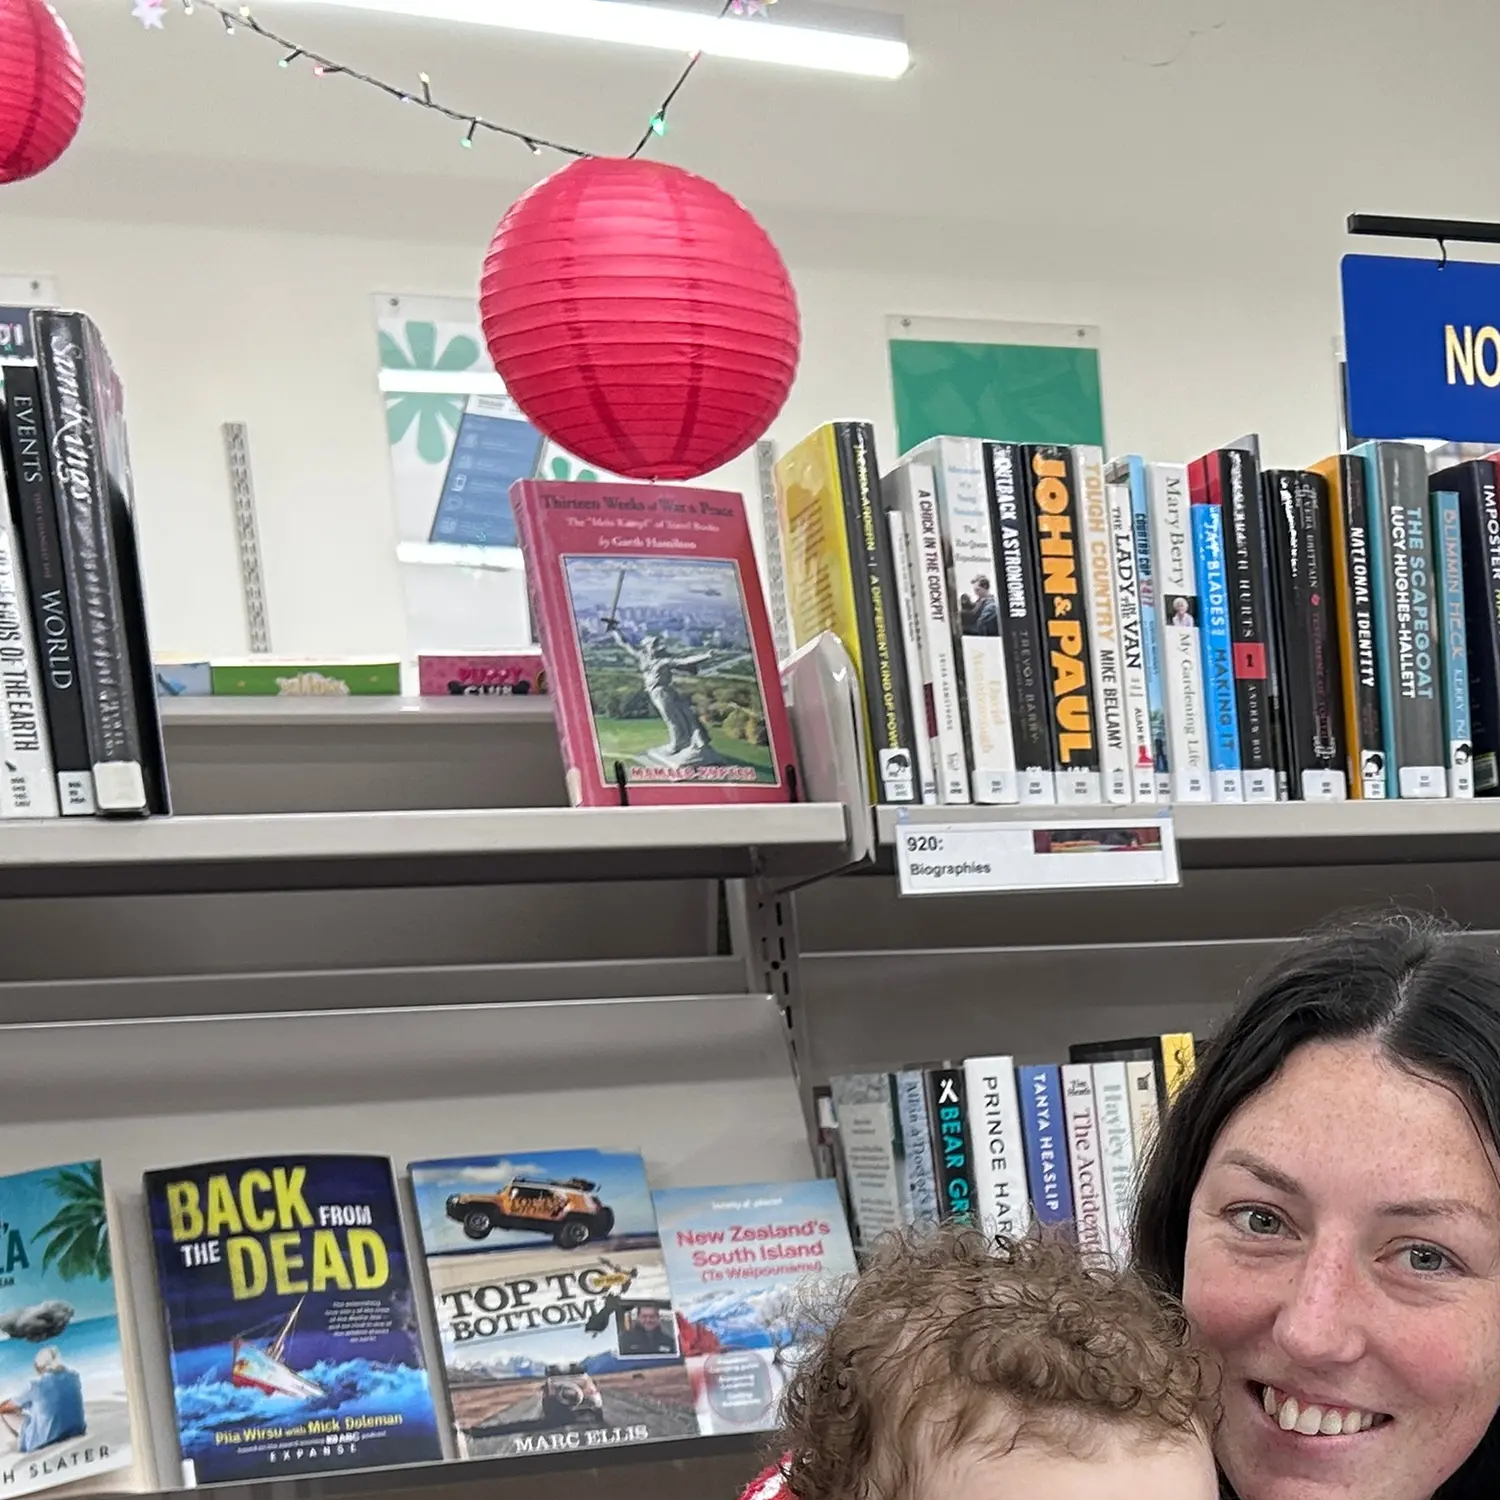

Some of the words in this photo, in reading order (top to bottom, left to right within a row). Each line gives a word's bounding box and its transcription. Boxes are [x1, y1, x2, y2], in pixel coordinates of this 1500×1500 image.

[543, 496, 600, 510] Thirteen
[603, 497, 645, 511] Weeks
[658, 498, 685, 513] War
[698, 502, 734, 517] Peace
[1031, 449, 1078, 595] JOHN
[1084, 463, 1104, 536] TOUGH
[1165, 477, 1179, 529] Mary
[13, 395, 44, 484] EVENTS
[40, 589, 75, 691] WORLD
[599, 534, 609, 549] by
[611, 536, 644, 548] Garth
[646, 537, 697, 549] Hamilton
[1389, 505, 1405, 551] LUCY
[1406, 507, 1423, 549] THE
[1167, 530, 1186, 588] Berry
[1350, 527, 1366, 606] NATIONAL
[1054, 597, 1073, 616] &
[1091, 541, 1114, 642] COUNTRY
[1356, 611, 1375, 688] IDENTITY
[1392, 553, 1415, 698] HUGHES-HALLETT
[1410, 555, 1433, 699] SCAPEGOAT
[1019, 629, 1033, 687] TREVOR
[1027, 692, 1041, 743] BARRY
[1048, 619, 1092, 764] PAUL
[1099, 650, 1116, 683] MIKE
[1102, 688, 1122, 750] BELLAMY
[906, 835, 944, 852] 920:
[910, 862, 991, 878] Biographies
[1032, 1073, 1047, 1132] TANYA
[1072, 1110, 1094, 1159] The
[1039, 1136, 1059, 1212] HEASLIP
[165, 1165, 315, 1244] BACK
[318, 1204, 373, 1228] FROM
[676, 1229, 725, 1247] New
[729, 1219, 831, 1242] Zealand's
[692, 1246, 756, 1266] South
[759, 1239, 825, 1261] Island
[180, 1239, 221, 1268] THE
[225, 1228, 391, 1302] DEAD
[702, 1269, 724, 1283] (Te
[440, 1275, 540, 1319] TOP
[545, 1268, 605, 1296] TO
[449, 1301, 600, 1343] BOTTOM
[214, 1430, 241, 1446] Piia
[243, 1427, 283, 1443] Wirsu
[308, 1418, 341, 1435] Mick
[344, 1412, 403, 1430] Doleman
[269, 1444, 359, 1463] EXPANSE
[512, 1432, 581, 1454] MARC
[585, 1424, 649, 1446] ELLIS
[28, 1445, 111, 1479] SLATER
